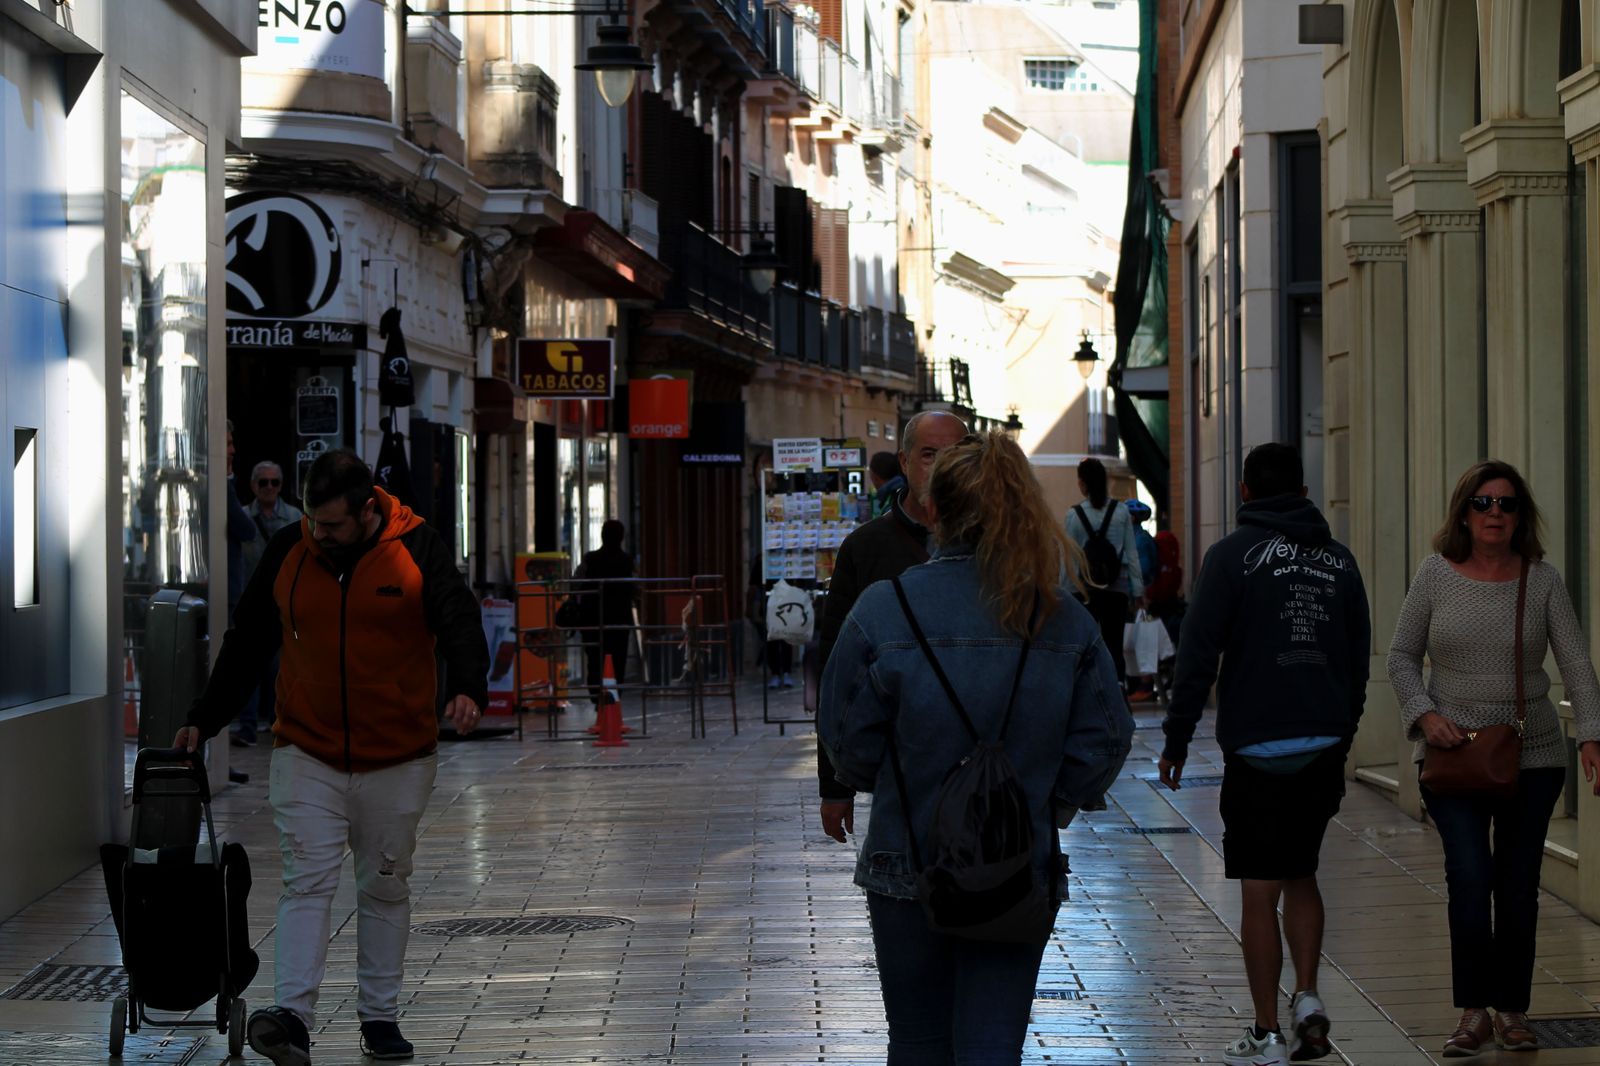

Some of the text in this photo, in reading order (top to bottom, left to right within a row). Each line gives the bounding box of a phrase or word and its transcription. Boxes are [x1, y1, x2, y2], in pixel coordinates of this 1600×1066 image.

[303, 324, 320, 339] de
[523, 374, 606, 390] TABACOS
[298, 387, 337, 395] OFERTA
[631, 423, 682, 438] orange
[682, 453, 742, 463] CALZEDONIA
[1244, 535, 1299, 576] Hey
[1273, 565, 1336, 582] OUT THERE
[1289, 584, 1321, 595] LONDON
[1280, 609, 1297, 620] LOS
